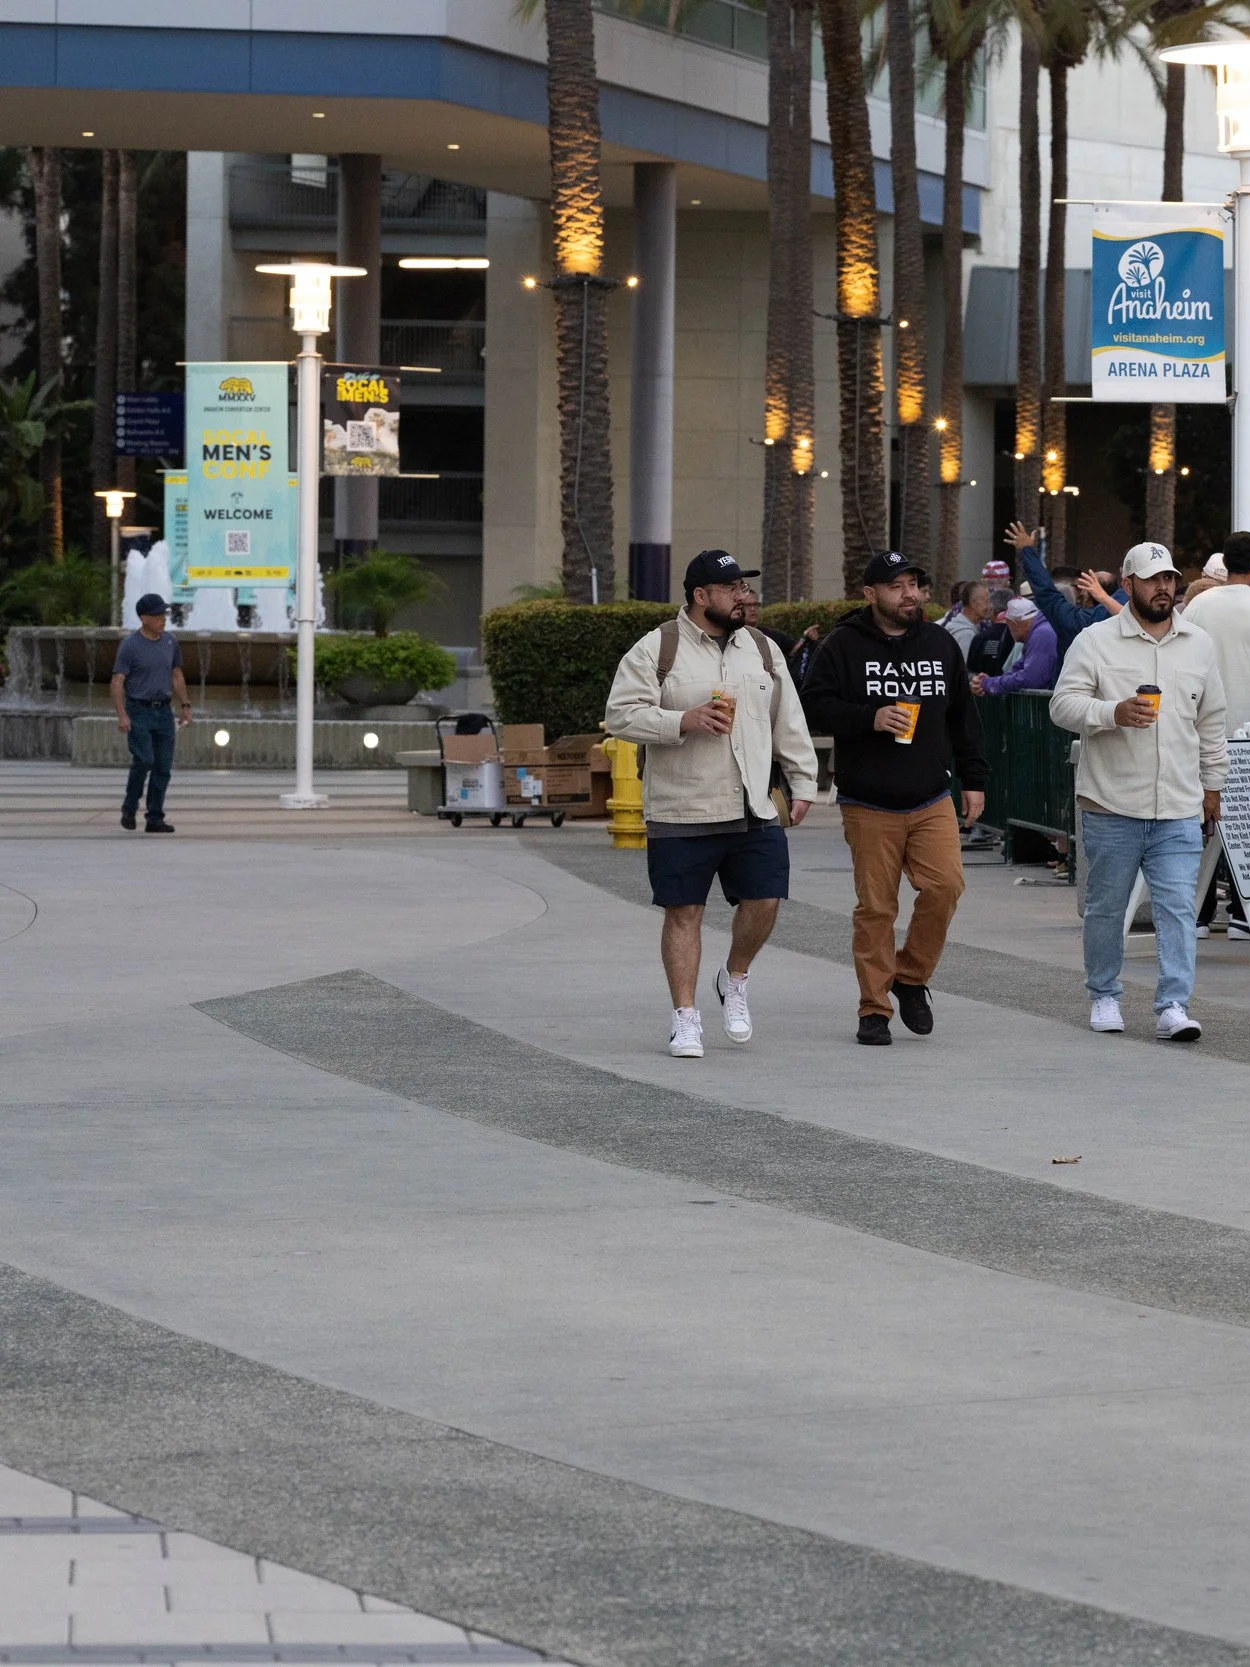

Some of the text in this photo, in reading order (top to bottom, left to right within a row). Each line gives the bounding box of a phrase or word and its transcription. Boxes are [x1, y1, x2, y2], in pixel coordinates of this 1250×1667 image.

[1107, 276, 1213, 325] Anaheim
[1131, 288, 1152, 299] visit
[1113, 331, 1206, 347] visitanaheim.org
[1107, 361, 1211, 379] ARENA PLAZA
[336, 377, 386, 392] SOCAL
[218, 392, 256, 402] MMXXV
[202, 429, 272, 446] SOCAL
[202, 444, 272, 461] MEN'S
[202, 460, 272, 480] CONF
[203, 508, 274, 520] WELCOME
[865, 660, 944, 677] RANGE
[866, 680, 946, 697] ROVER
